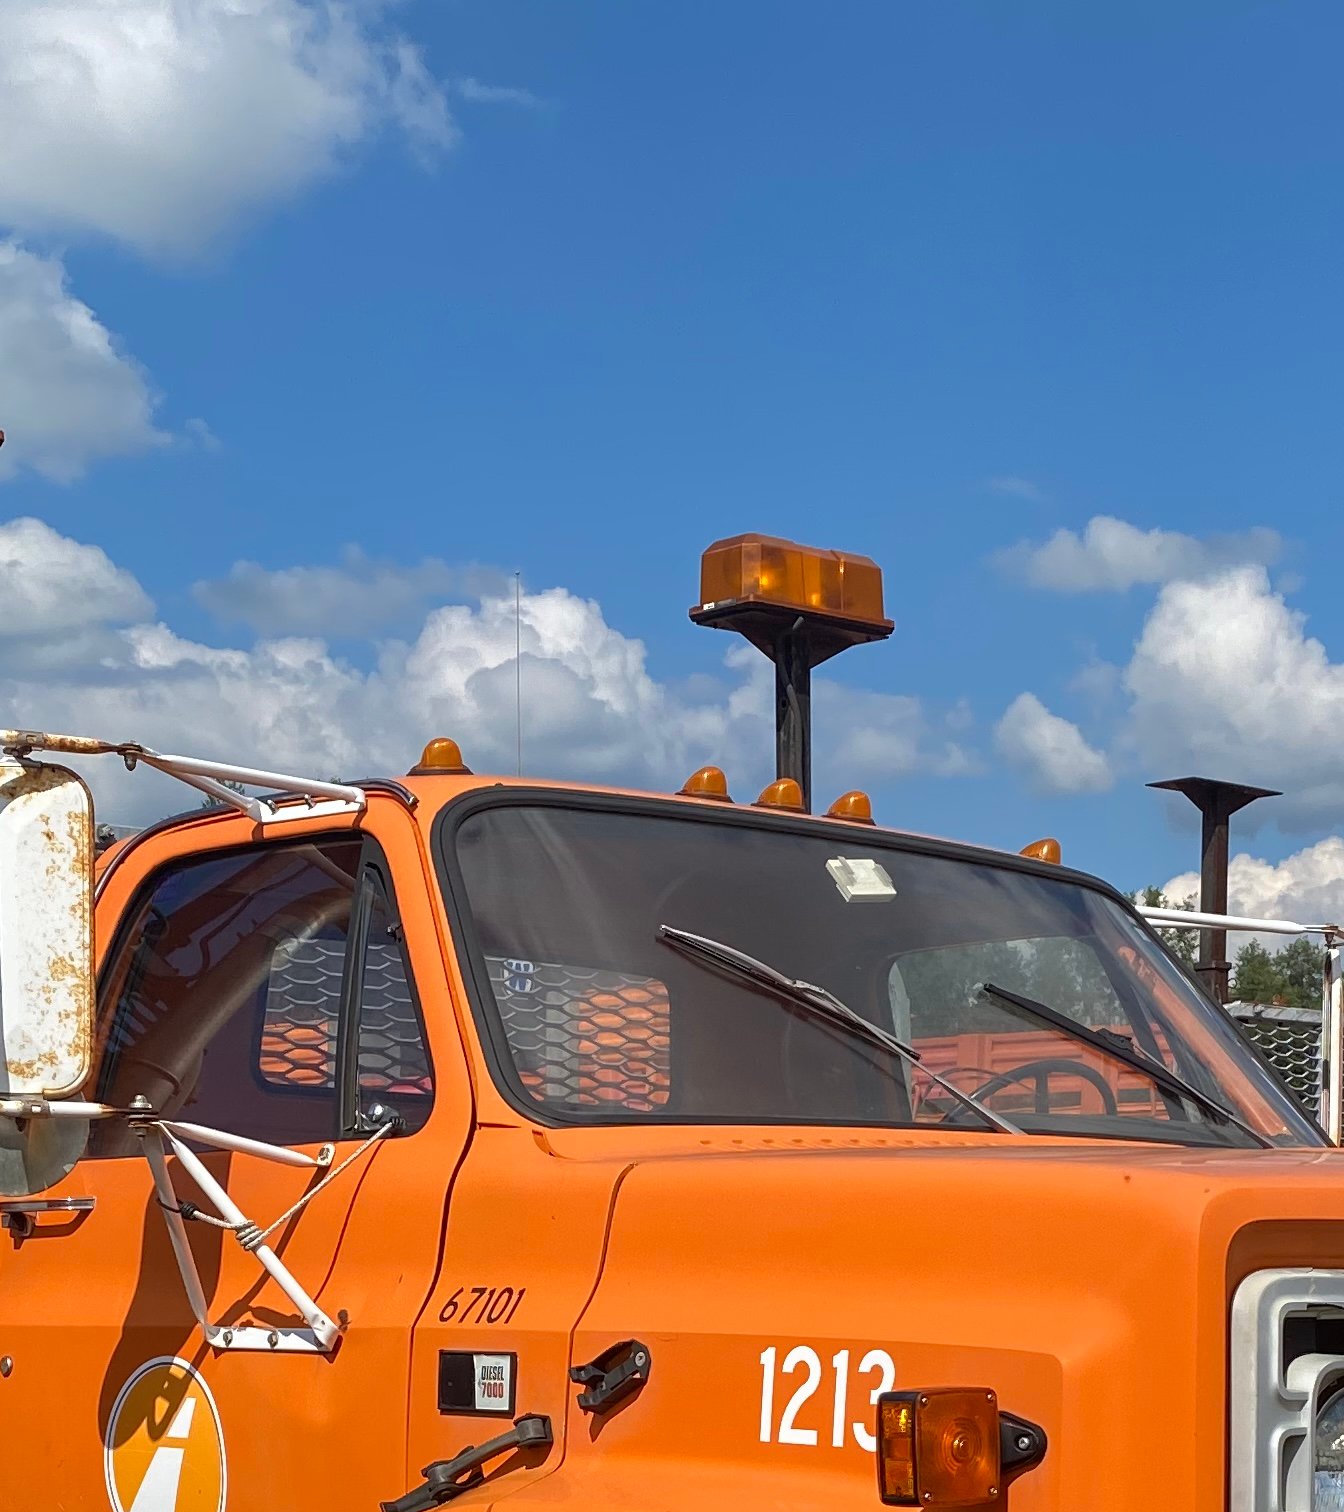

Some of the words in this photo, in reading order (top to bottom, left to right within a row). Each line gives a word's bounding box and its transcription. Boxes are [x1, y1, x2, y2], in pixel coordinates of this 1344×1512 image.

[439, 1286, 526, 1324] 67101
[481, 1365, 505, 1381] DIESEL
[481, 1382, 504, 1399] 7000
[759, 1345, 896, 1453] 1213
